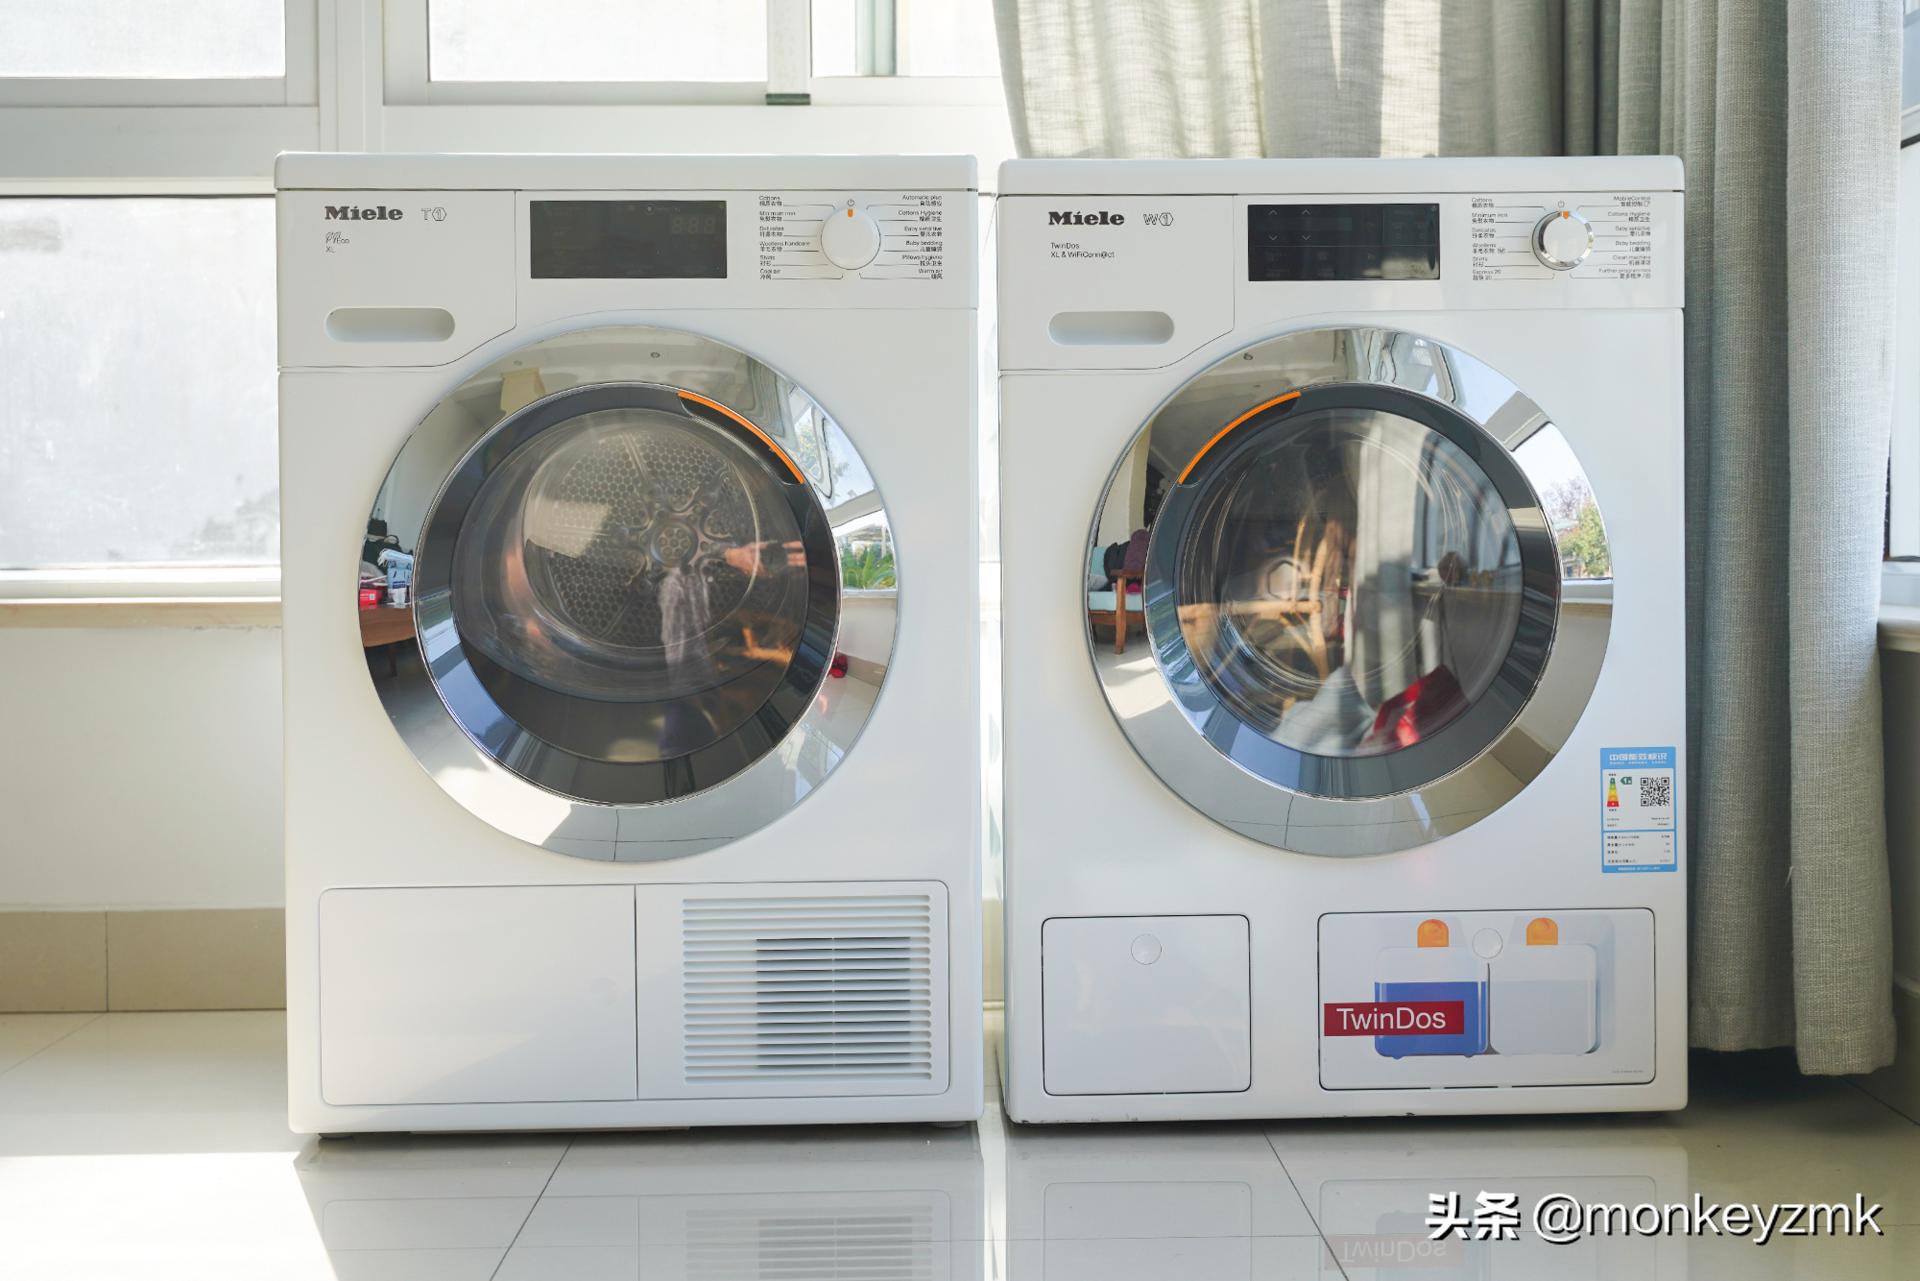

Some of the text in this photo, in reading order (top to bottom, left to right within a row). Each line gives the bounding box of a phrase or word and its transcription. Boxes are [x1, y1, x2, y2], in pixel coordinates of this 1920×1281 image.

[324, 205, 403, 221] Miele
[1049, 211, 1125, 226] Miele
[1336, 1007, 1447, 1031] TwinDos
